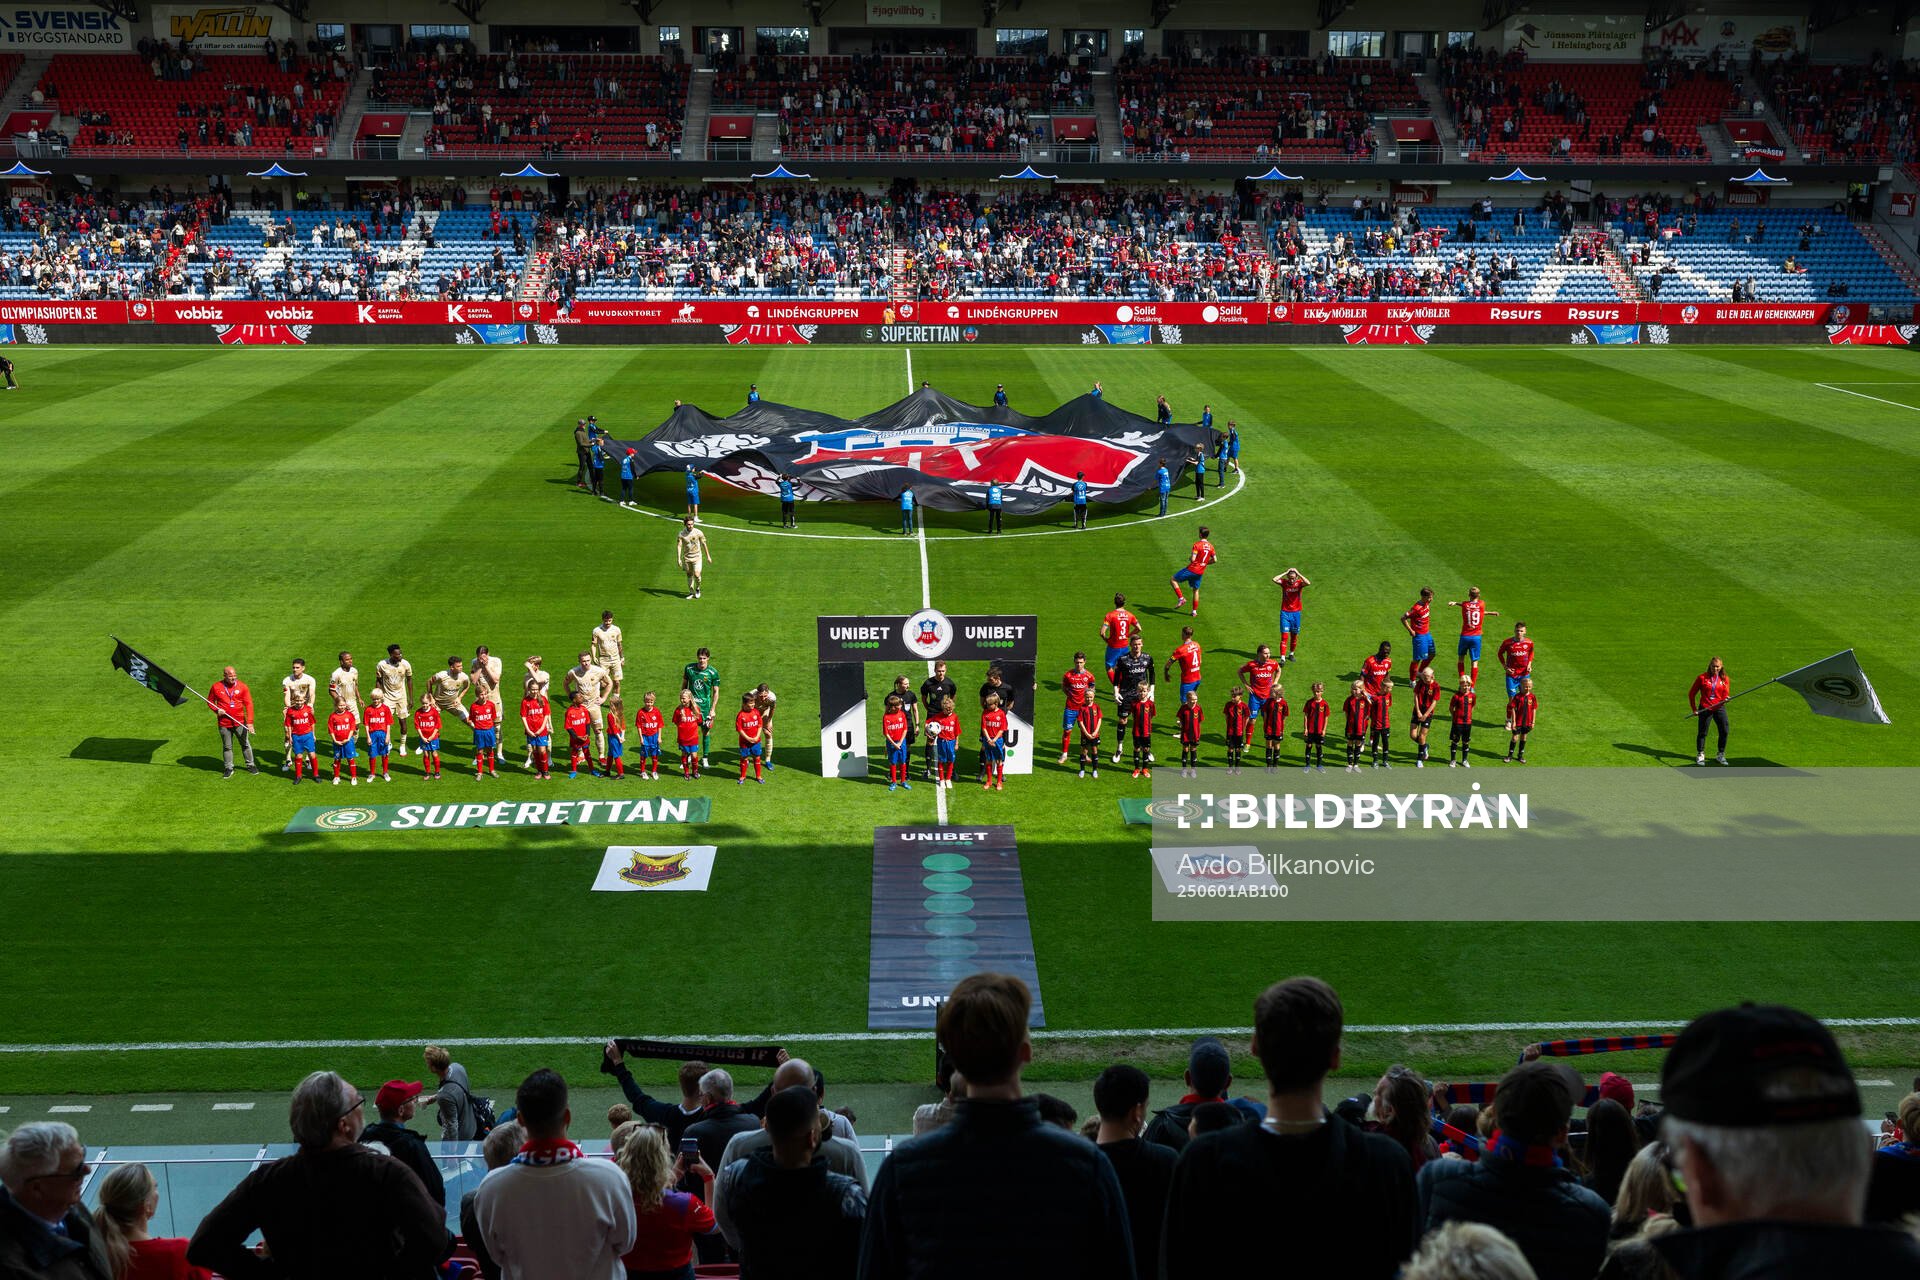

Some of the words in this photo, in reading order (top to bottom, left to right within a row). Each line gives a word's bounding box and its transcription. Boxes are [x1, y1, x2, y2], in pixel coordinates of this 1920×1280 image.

[16, 11, 121, 30] SVENSK
[170, 13, 273, 43] WALLIN
[1661, 19, 1702, 46] MAX
[17, 32, 124, 45] BYGGSTANDARD
[1557, 40, 1611, 51] Helsingborg
[1613, 41, 1627, 49] AB
[1, 306, 98, 320] OLYMPIASHOPEN.SE
[175, 306, 223, 320] vobbiz
[265, 306, 314, 320] vobbiz
[767, 305, 859, 318] LINDÉNGRUPPEN
[967, 305, 1058, 318] LINDÉNGRUPPEN
[1133, 305, 1156, 316] Solid
[1219, 305, 1242, 316] Solid
[1331, 306, 1368, 318] MÖBLER
[1414, 306, 1451, 318] MÖBLER
[1490, 308, 1542, 320] Resurs
[1568, 308, 1620, 320] Resurs
[1716, 309, 1728, 320] BLI
[1729, 309, 1739, 319] EN
[1740, 309, 1753, 319] DEL
[1754, 309, 1763, 319] AV
[1765, 309, 1815, 320] GEMENSKAPEN
[881, 326, 960, 342] SUPERETTAN
[1465, 610, 1481, 626] 19
[830, 626, 891, 640] UNIBET
[965, 626, 1025, 639] UNIBET
[1119, 620, 1127, 636] 3
[1191, 651, 1200, 667] 4
[836, 731, 852, 750] U
[390, 798, 689, 828] SUPERETTAN
[901, 832, 988, 841] UNIBET
